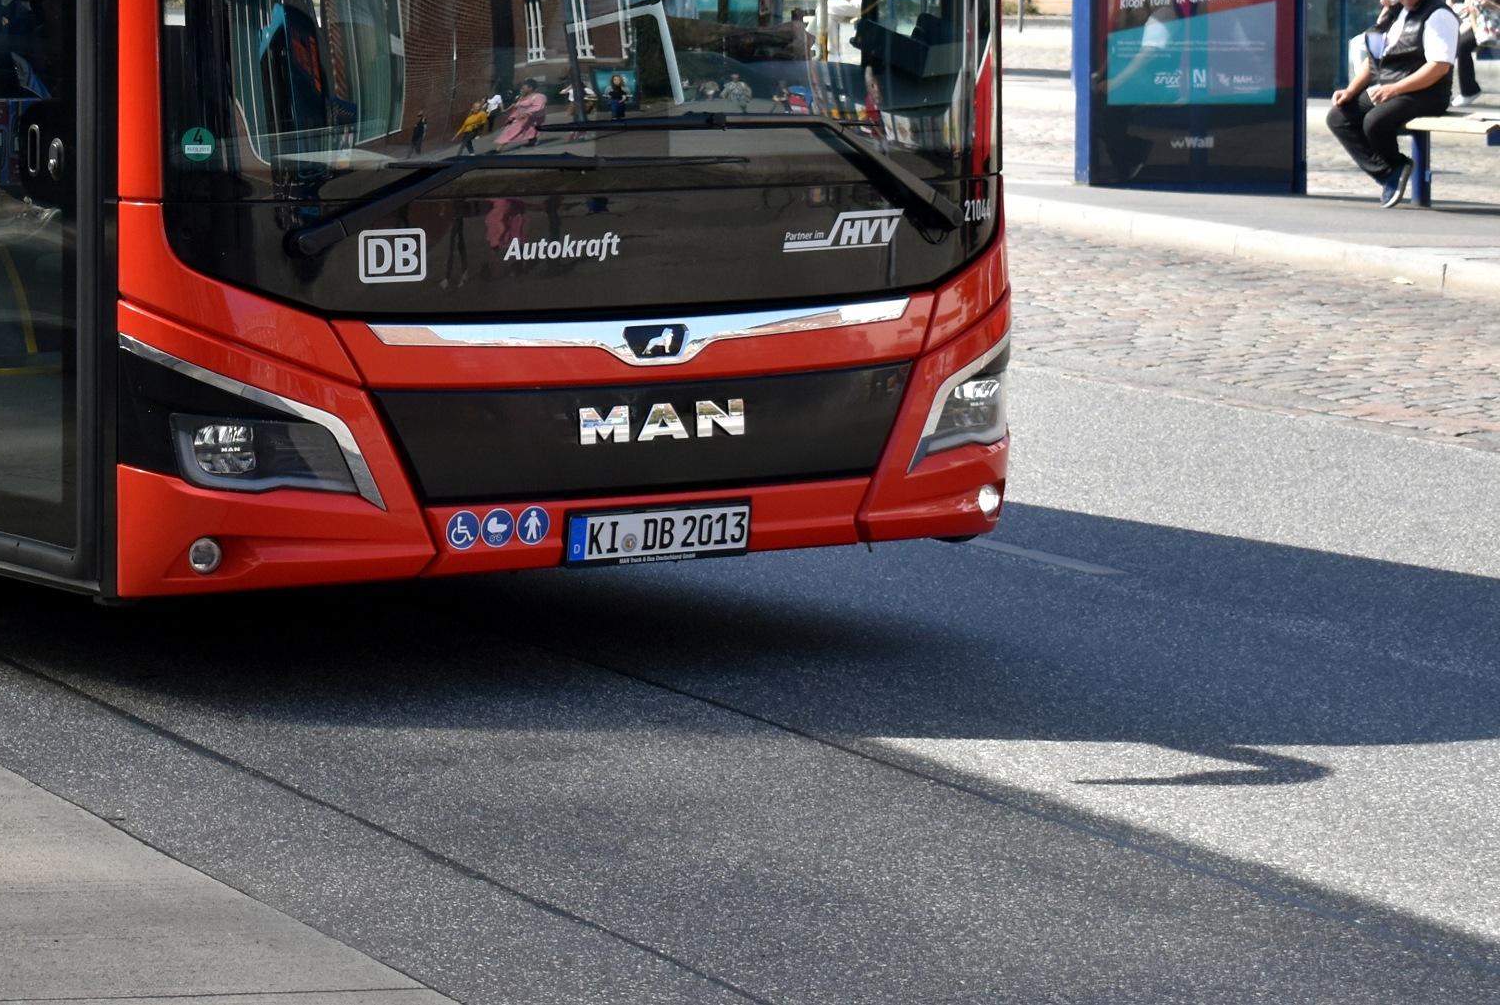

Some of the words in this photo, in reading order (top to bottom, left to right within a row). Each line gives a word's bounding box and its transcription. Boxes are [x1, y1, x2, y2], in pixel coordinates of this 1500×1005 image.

[193, 128, 204, 145] 4
[964, 198, 991, 223] 21044
[784, 231, 813, 242] Partner
[814, 232, 825, 240] im
[839, 217, 901, 246] HVV
[366, 236, 419, 276] DB
[503, 232, 621, 262] Autokraft
[579, 398, 746, 445] MAN
[587, 521, 619, 556] KI
[641, 517, 676, 551] DB
[680, 511, 747, 548] 2013
[573, 544, 581, 555] D
